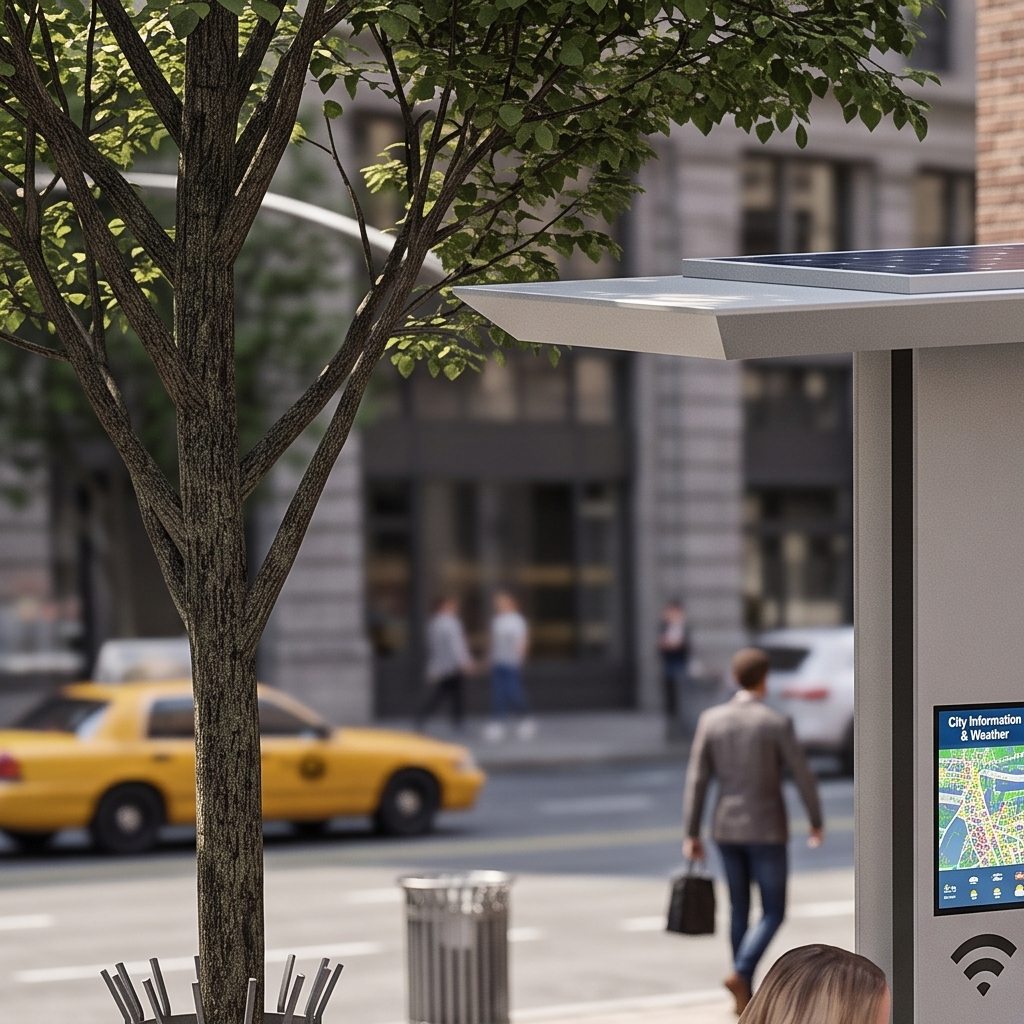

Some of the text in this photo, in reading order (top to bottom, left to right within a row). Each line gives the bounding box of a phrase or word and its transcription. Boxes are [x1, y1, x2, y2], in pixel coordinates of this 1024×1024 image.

[948, 714, 1021, 730] City Information
[960, 729, 1010, 741] & Weather
